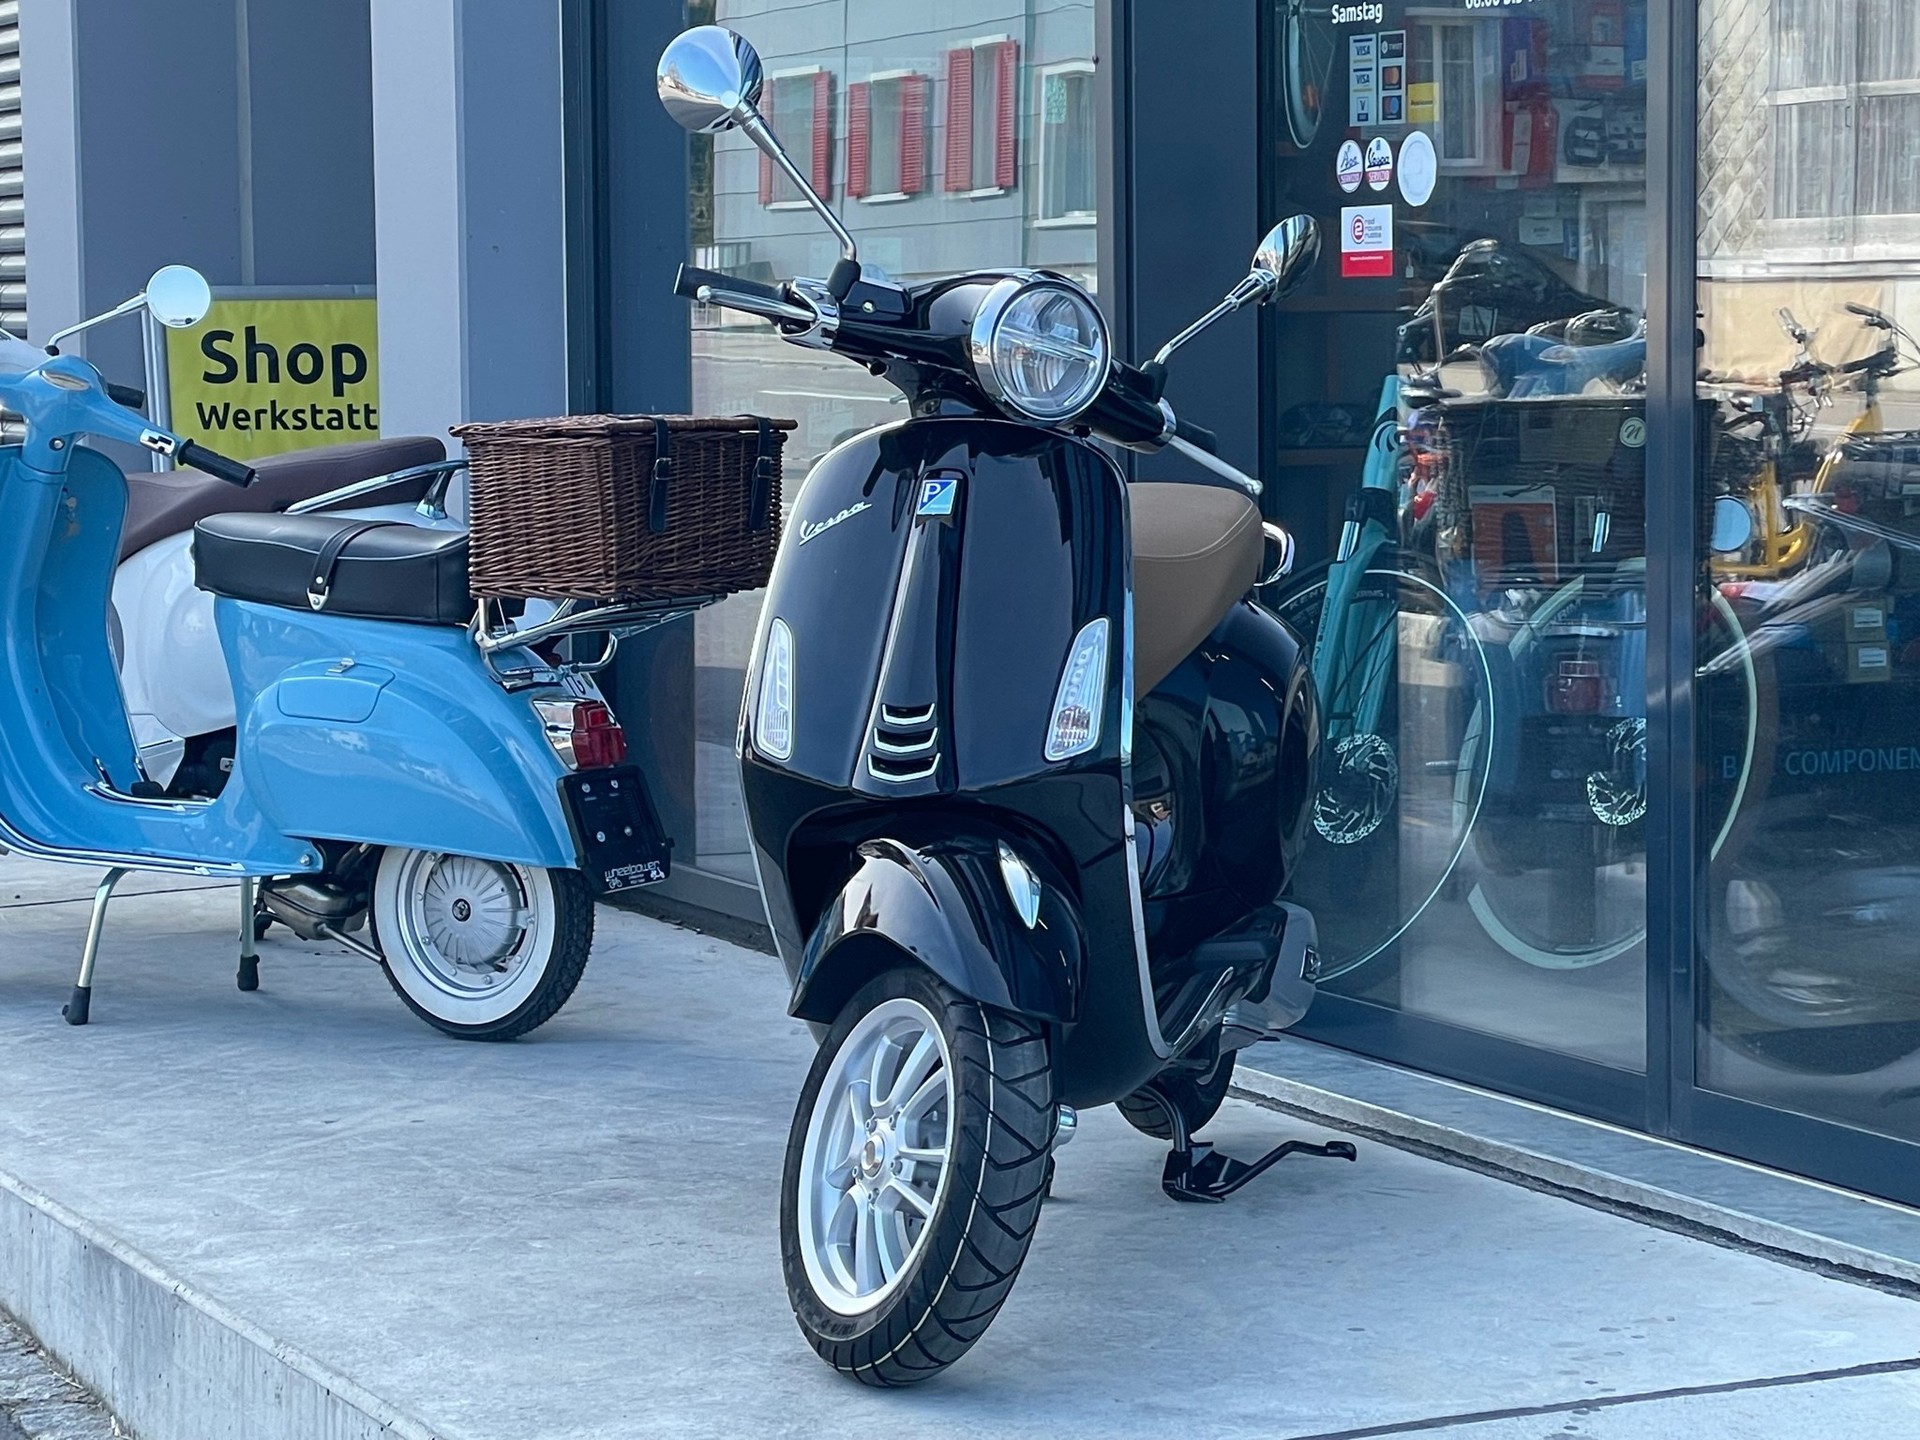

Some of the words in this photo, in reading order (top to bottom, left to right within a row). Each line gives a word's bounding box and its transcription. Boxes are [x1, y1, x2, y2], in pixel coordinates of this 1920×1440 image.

[1331, 2, 1383, 24] Samstag
[1356, 45, 1370, 56] VISA
[1355, 74, 1370, 85] VISA
[1367, 146, 1390, 168] Vespa
[201, 326, 367, 397] Shop
[195, 400, 378, 430] Werkstatt
[922, 483, 941, 503] P
[799, 501, 872, 546] Vespa
[604, 860, 660, 880] wheelpower
